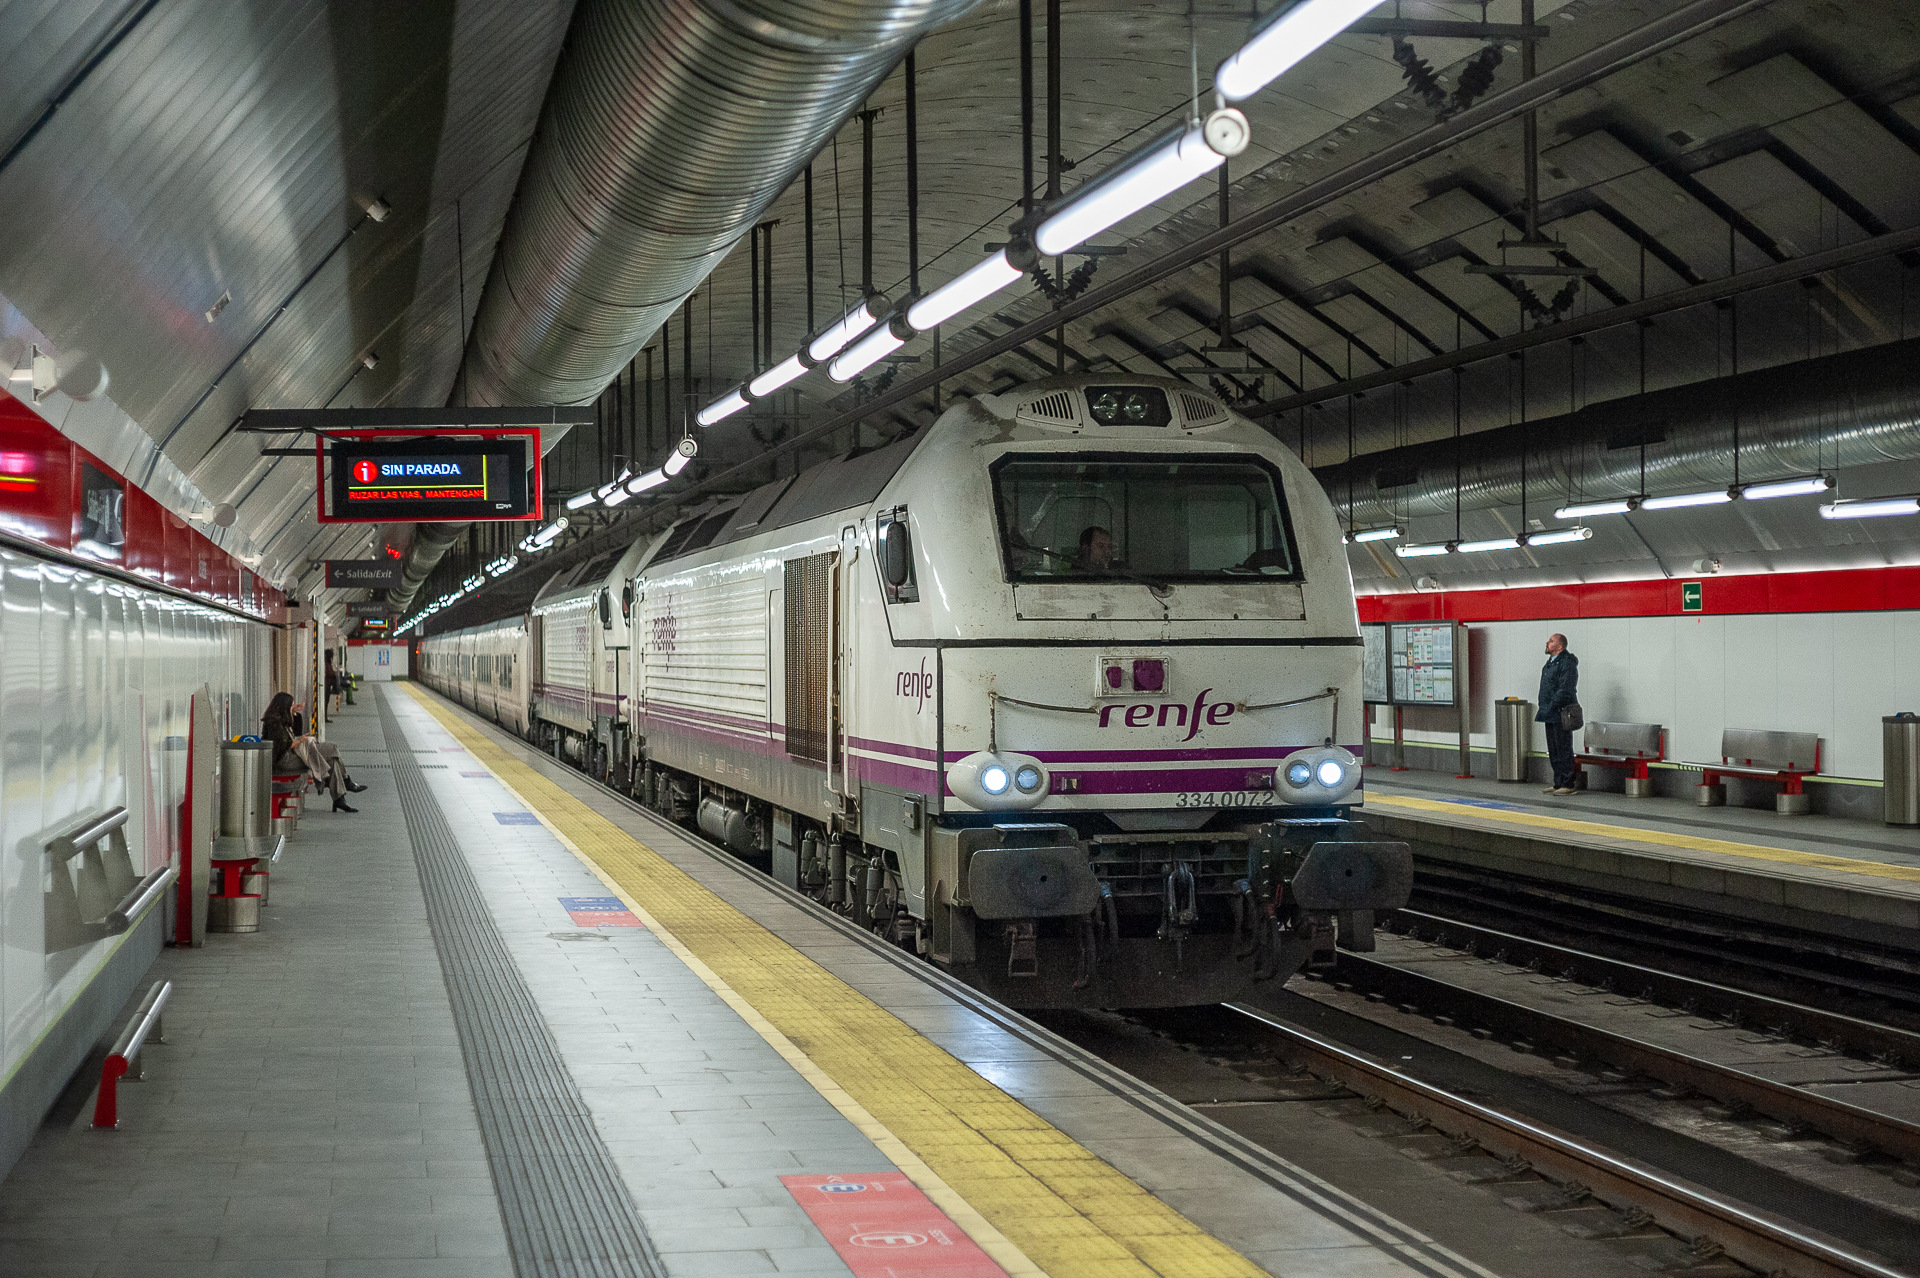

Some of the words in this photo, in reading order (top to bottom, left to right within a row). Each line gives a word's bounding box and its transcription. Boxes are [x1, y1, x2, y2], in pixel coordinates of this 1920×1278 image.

[381, 464, 405, 476] SIN
[406, 463, 462, 476] PARADA
[380, 491, 399, 499] LAS
[346, 569, 392, 579] Salida/Exit
[896, 656, 933, 715] renfe
[1098, 688, 1236, 742] renfe
[1175, 791, 1274, 807] 334.007.2
